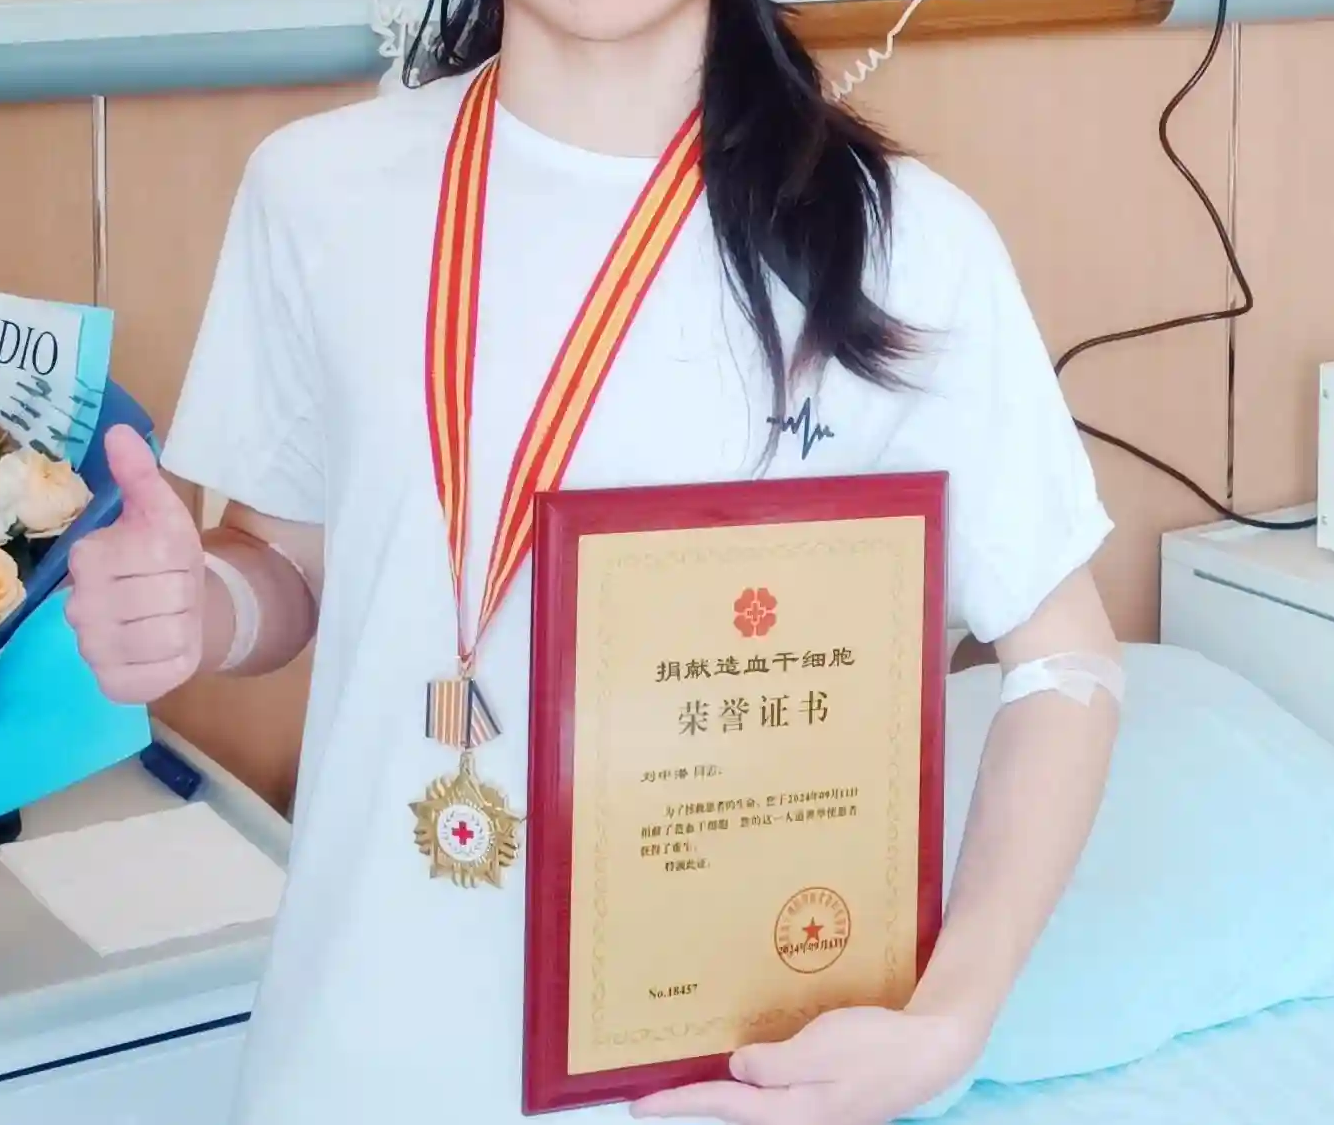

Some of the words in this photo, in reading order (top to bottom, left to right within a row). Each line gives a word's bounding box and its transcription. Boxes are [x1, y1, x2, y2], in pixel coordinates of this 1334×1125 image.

[654, 647, 857, 683] 捐献造血干细胞
[677, 690, 829, 736] 荣誉证书
